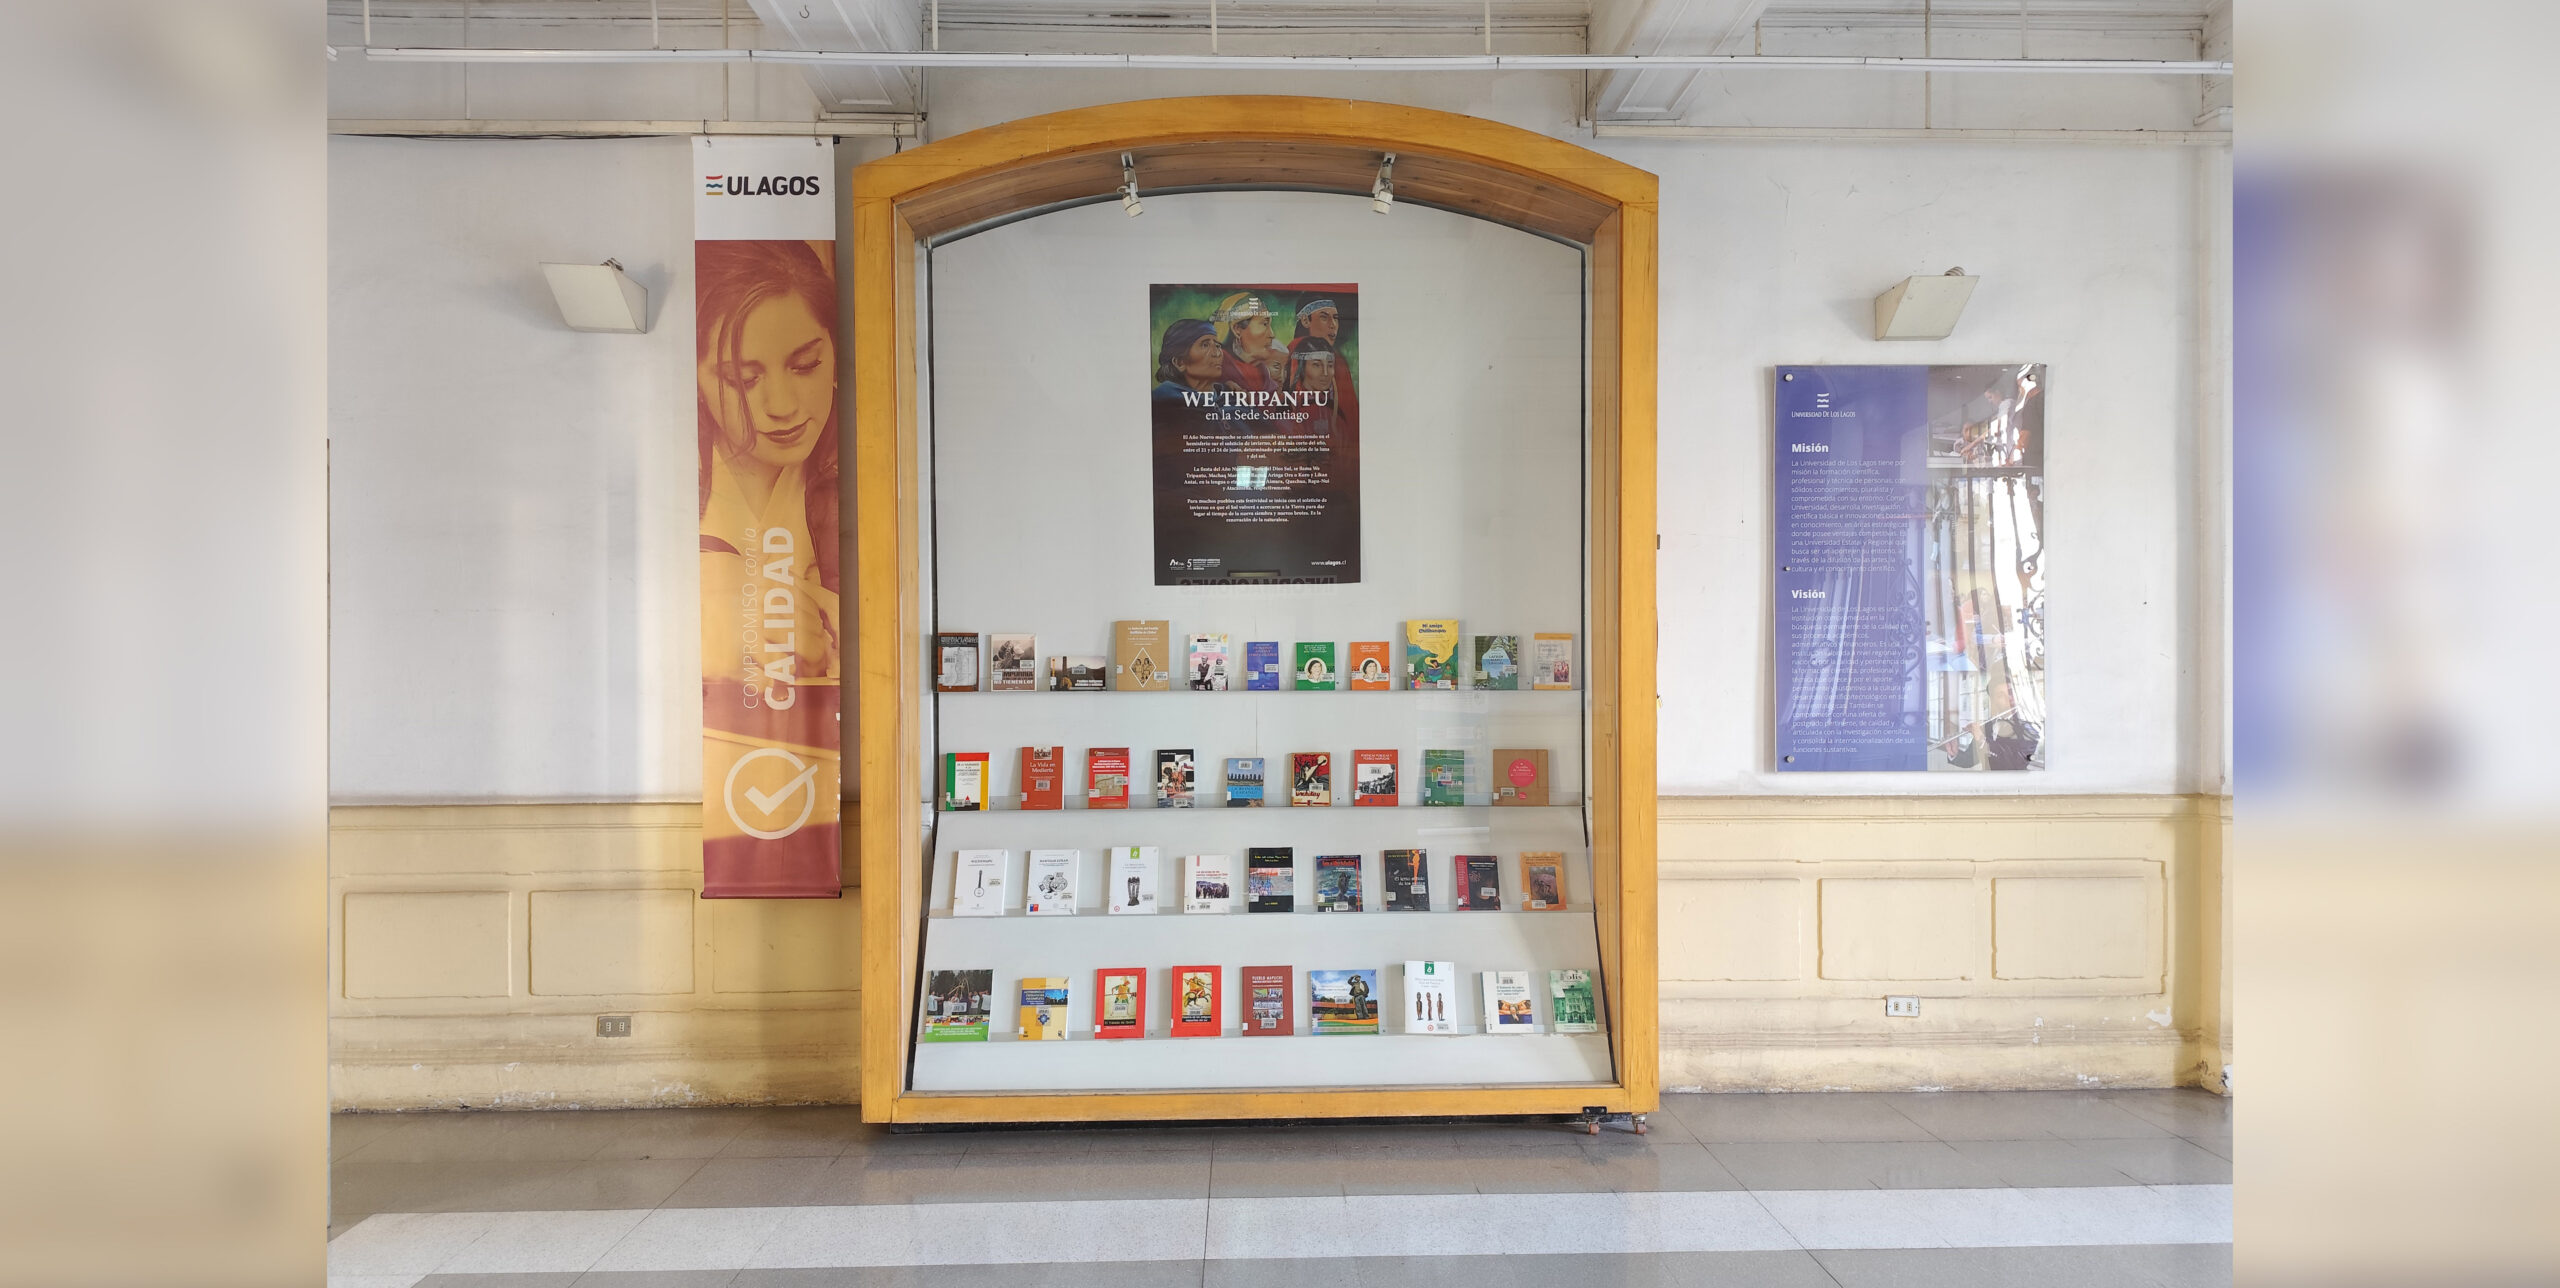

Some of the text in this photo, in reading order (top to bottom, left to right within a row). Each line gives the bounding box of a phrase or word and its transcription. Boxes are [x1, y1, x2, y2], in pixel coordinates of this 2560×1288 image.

[726, 175, 820, 196] ULAGOS
[1182, 390, 1329, 407] WE TRIPANTU
[1205, 409, 1310, 423] en la Sede Santiago
[1791, 442, 1829, 453] Misión
[1310, 559, 1347, 567] www.ulagos.cl
[1791, 589, 1826, 599] Visión
[740, 527, 759, 710] COMPROMISO con la
[762, 526, 796, 711] CALIDAD
